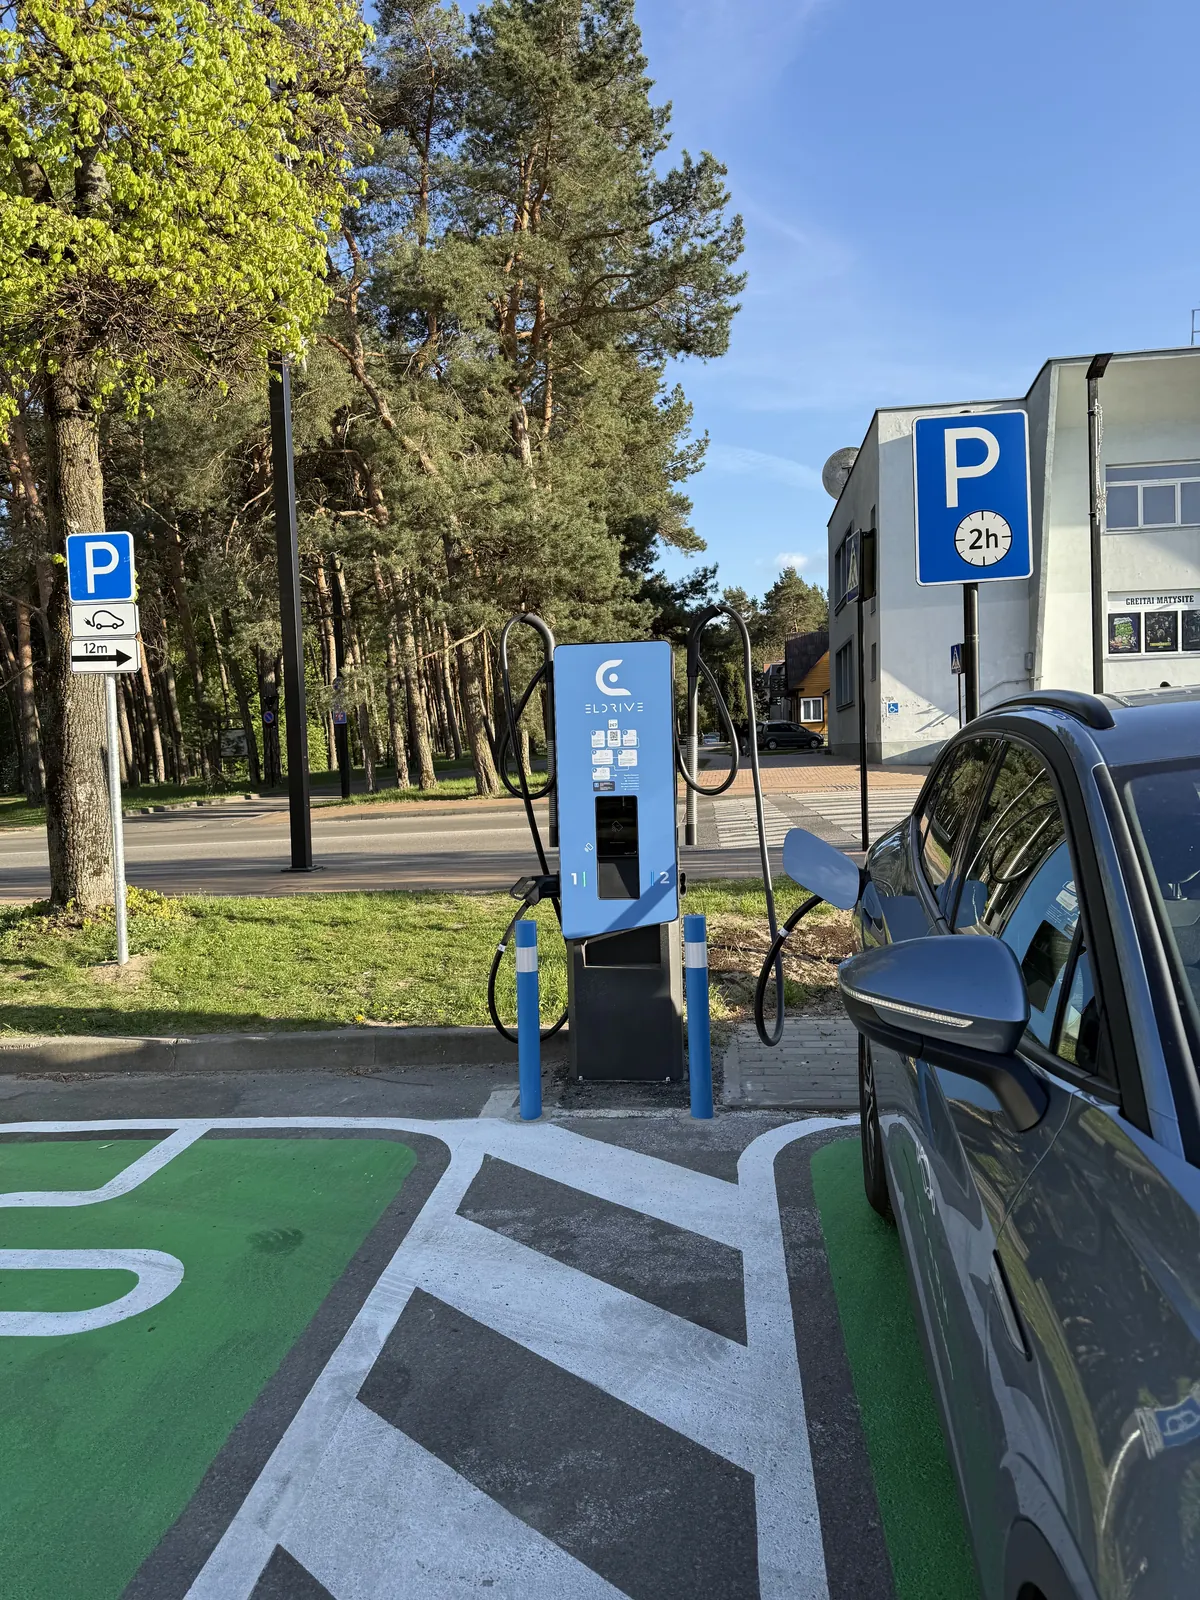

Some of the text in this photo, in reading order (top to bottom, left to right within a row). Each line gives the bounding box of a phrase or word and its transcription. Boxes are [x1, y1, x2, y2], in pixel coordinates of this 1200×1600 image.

[944, 426, 1000, 509] P
[969, 528, 999, 550] 2h
[84, 541, 120, 594] P
[1125, 595, 1195, 606] GREITAI MATYSITE
[83, 642, 108, 654] 12m
[585, 702, 644, 714] ELDRIVE
[570, 872, 578, 886] 1
[659, 871, 670, 884] 2
